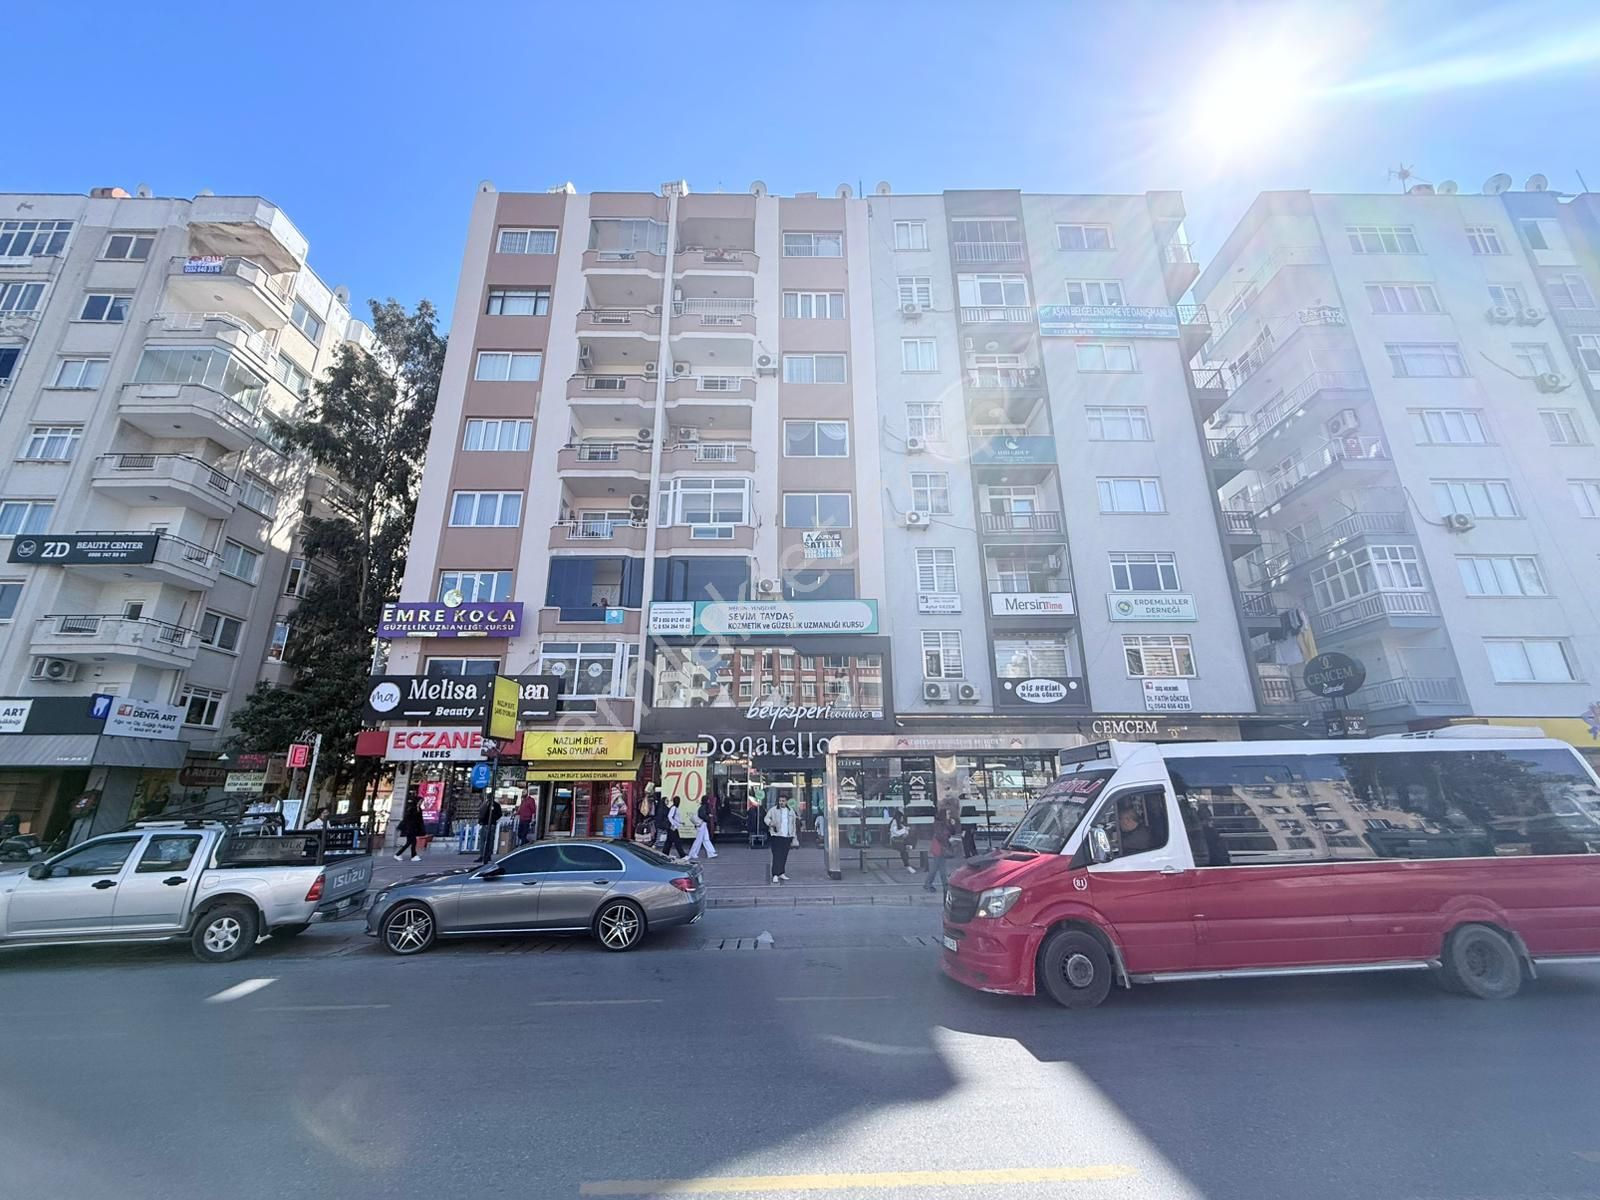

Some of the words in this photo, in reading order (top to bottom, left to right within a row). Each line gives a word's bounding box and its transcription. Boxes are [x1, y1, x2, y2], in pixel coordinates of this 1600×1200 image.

[41, 542, 70, 558] ZD
[383, 609, 445, 623] EMRE
[454, 609, 516, 623] KOCA
[728, 612, 757, 621] SEVİM
[760, 612, 794, 621] TAYDAŞ
[728, 620, 762, 630] KOZMETİK
[763, 622, 770, 630] ve
[771, 620, 802, 630] GÜZELLİK
[804, 620, 841, 629] UZMANLIĞI
[842, 619, 865, 629] KURSU
[408, 678, 478, 701] Melisa
[2, 708, 26, 716] ART
[133, 710, 160, 720] DENTA
[161, 714, 178, 722] ART
[435, 706, 475, 717] Beauty
[746, 696, 834, 730] beyazperi
[1092, 720, 1159, 734] CEMCEM
[393, 731, 483, 749] ECZANE
[583, 735, 604, 745] BÜFE
[695, 731, 832, 759] Donatello
[421, 750, 451, 759] NEFES
[546, 747, 568, 757] ŞANS
[569, 747, 609, 755] OYUNLARI
[665, 758, 704, 768] İNDİRİM
[664, 770, 703, 802] 70
[333, 868, 367, 888] ISUZU
